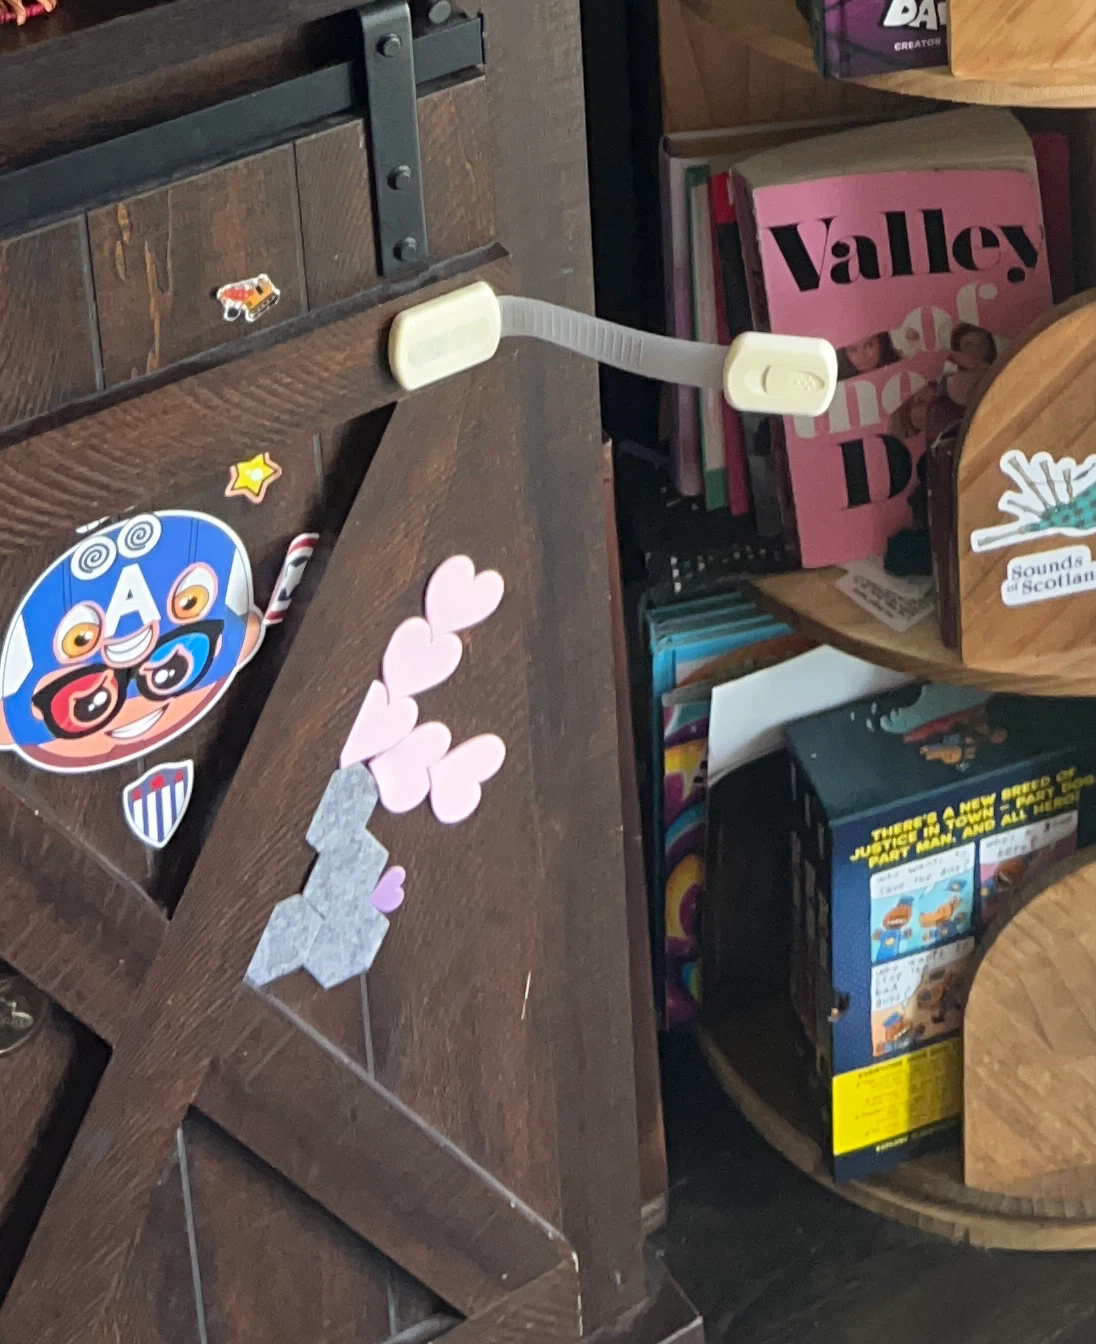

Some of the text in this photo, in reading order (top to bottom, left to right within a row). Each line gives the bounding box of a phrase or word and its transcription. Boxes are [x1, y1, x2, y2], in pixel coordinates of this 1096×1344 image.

[768, 208, 1044, 293] Valley
[104, 565, 162, 639] A
[1011, 554, 1084, 581] Sounds
[850, 830, 918, 861] JUSTICE
[923, 823, 940, 838] IN
[945, 807, 995, 832] TOWN
[1016, 787, 1055, 808] PART
[868, 846, 911, 869] PART
[962, 819, 996, 839] AND
[1001, 810, 1028, 827] ALL
[871, 766, 1077, 842] THERE'S A NEW BREED OF
